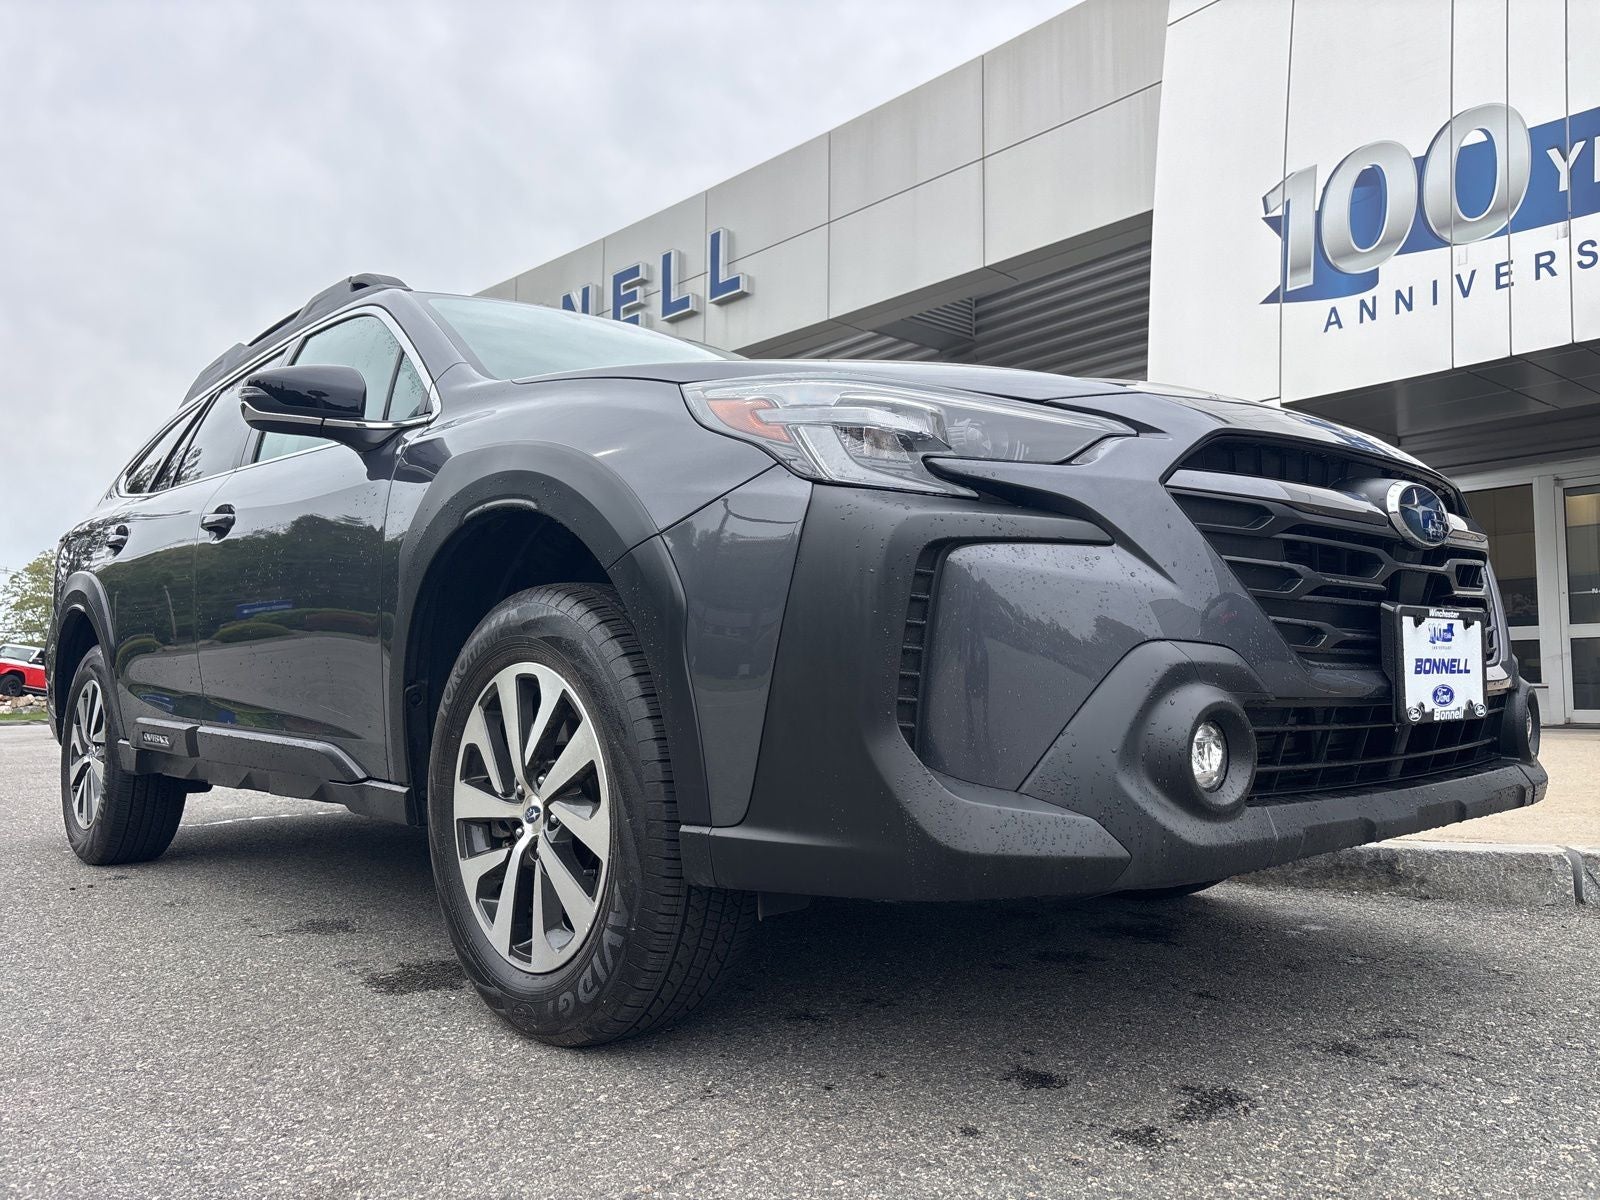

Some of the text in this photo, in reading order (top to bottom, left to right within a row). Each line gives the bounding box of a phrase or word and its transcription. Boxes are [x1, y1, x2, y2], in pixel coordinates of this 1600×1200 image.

[1260, 102, 1531, 292] 100
[1323, 238, 1599, 333] ANNIVERS
[1429, 609, 1459, 618] Winchester
[1414, 658, 1470, 674] BONNELL
[1433, 707, 1463, 720] Bonnell
